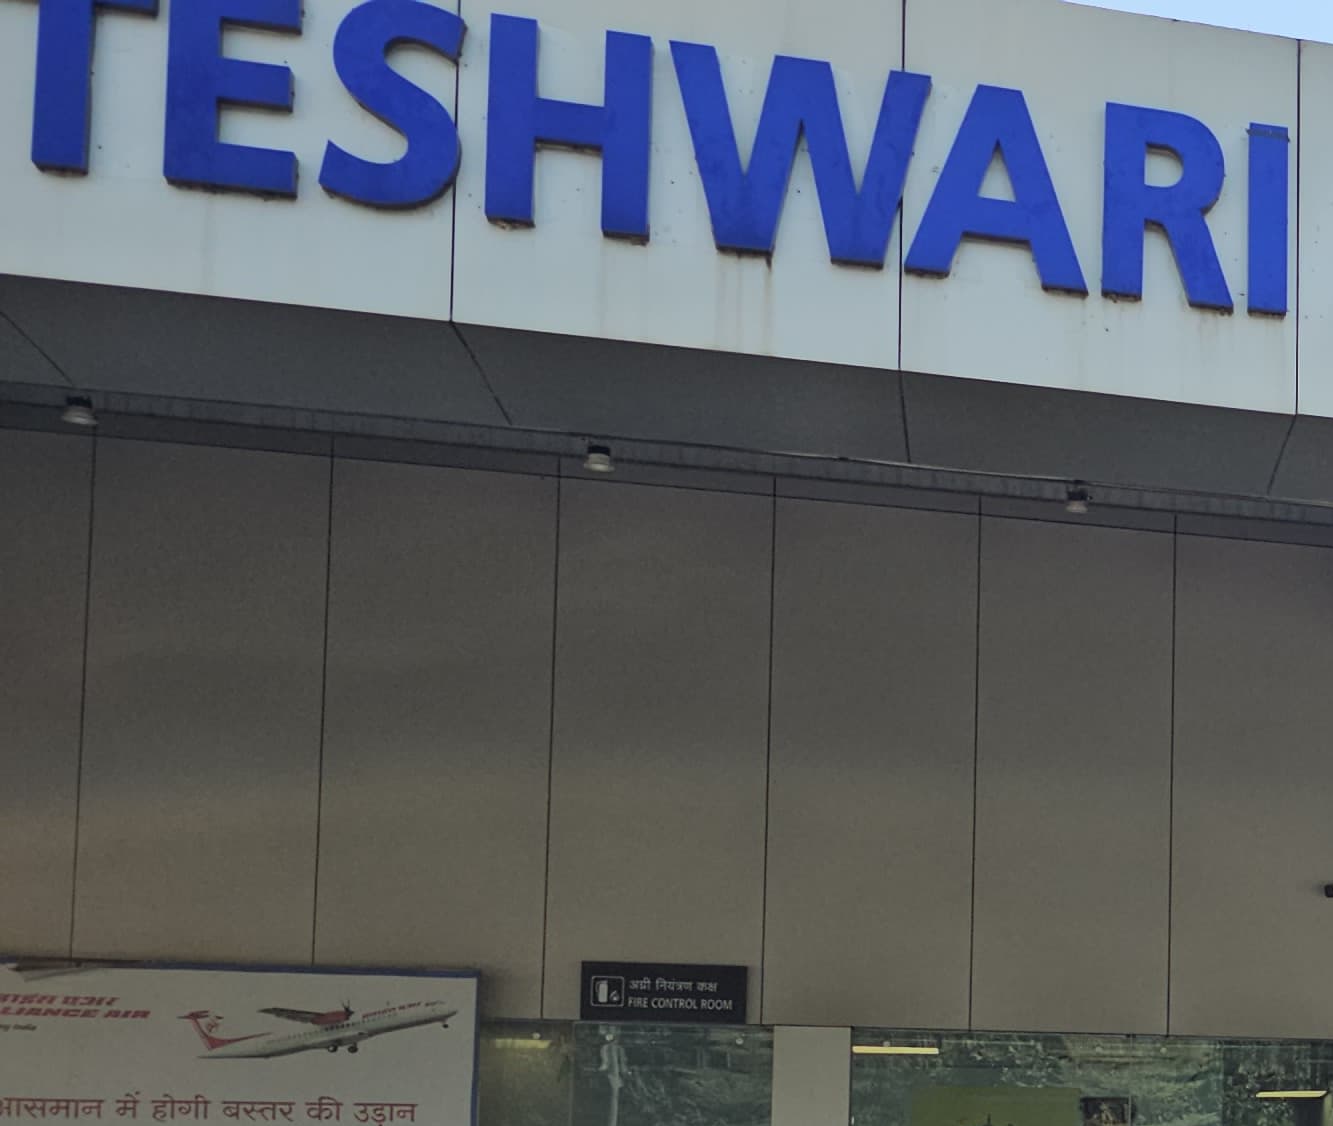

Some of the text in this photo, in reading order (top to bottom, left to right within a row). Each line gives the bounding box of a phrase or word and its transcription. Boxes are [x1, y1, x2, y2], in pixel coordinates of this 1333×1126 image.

[8, 0, 1290, 318] TESHWARI
[104, 1009, 151, 1019] AIR
[627, 997, 733, 1010] FIRE CONTROL ROOM
[115, 1091, 142, 1121] में
[152, 1094, 210, 1122] होगी
[222, 1100, 295, 1122] बस्तर
[306, 1096, 345, 1123] की
